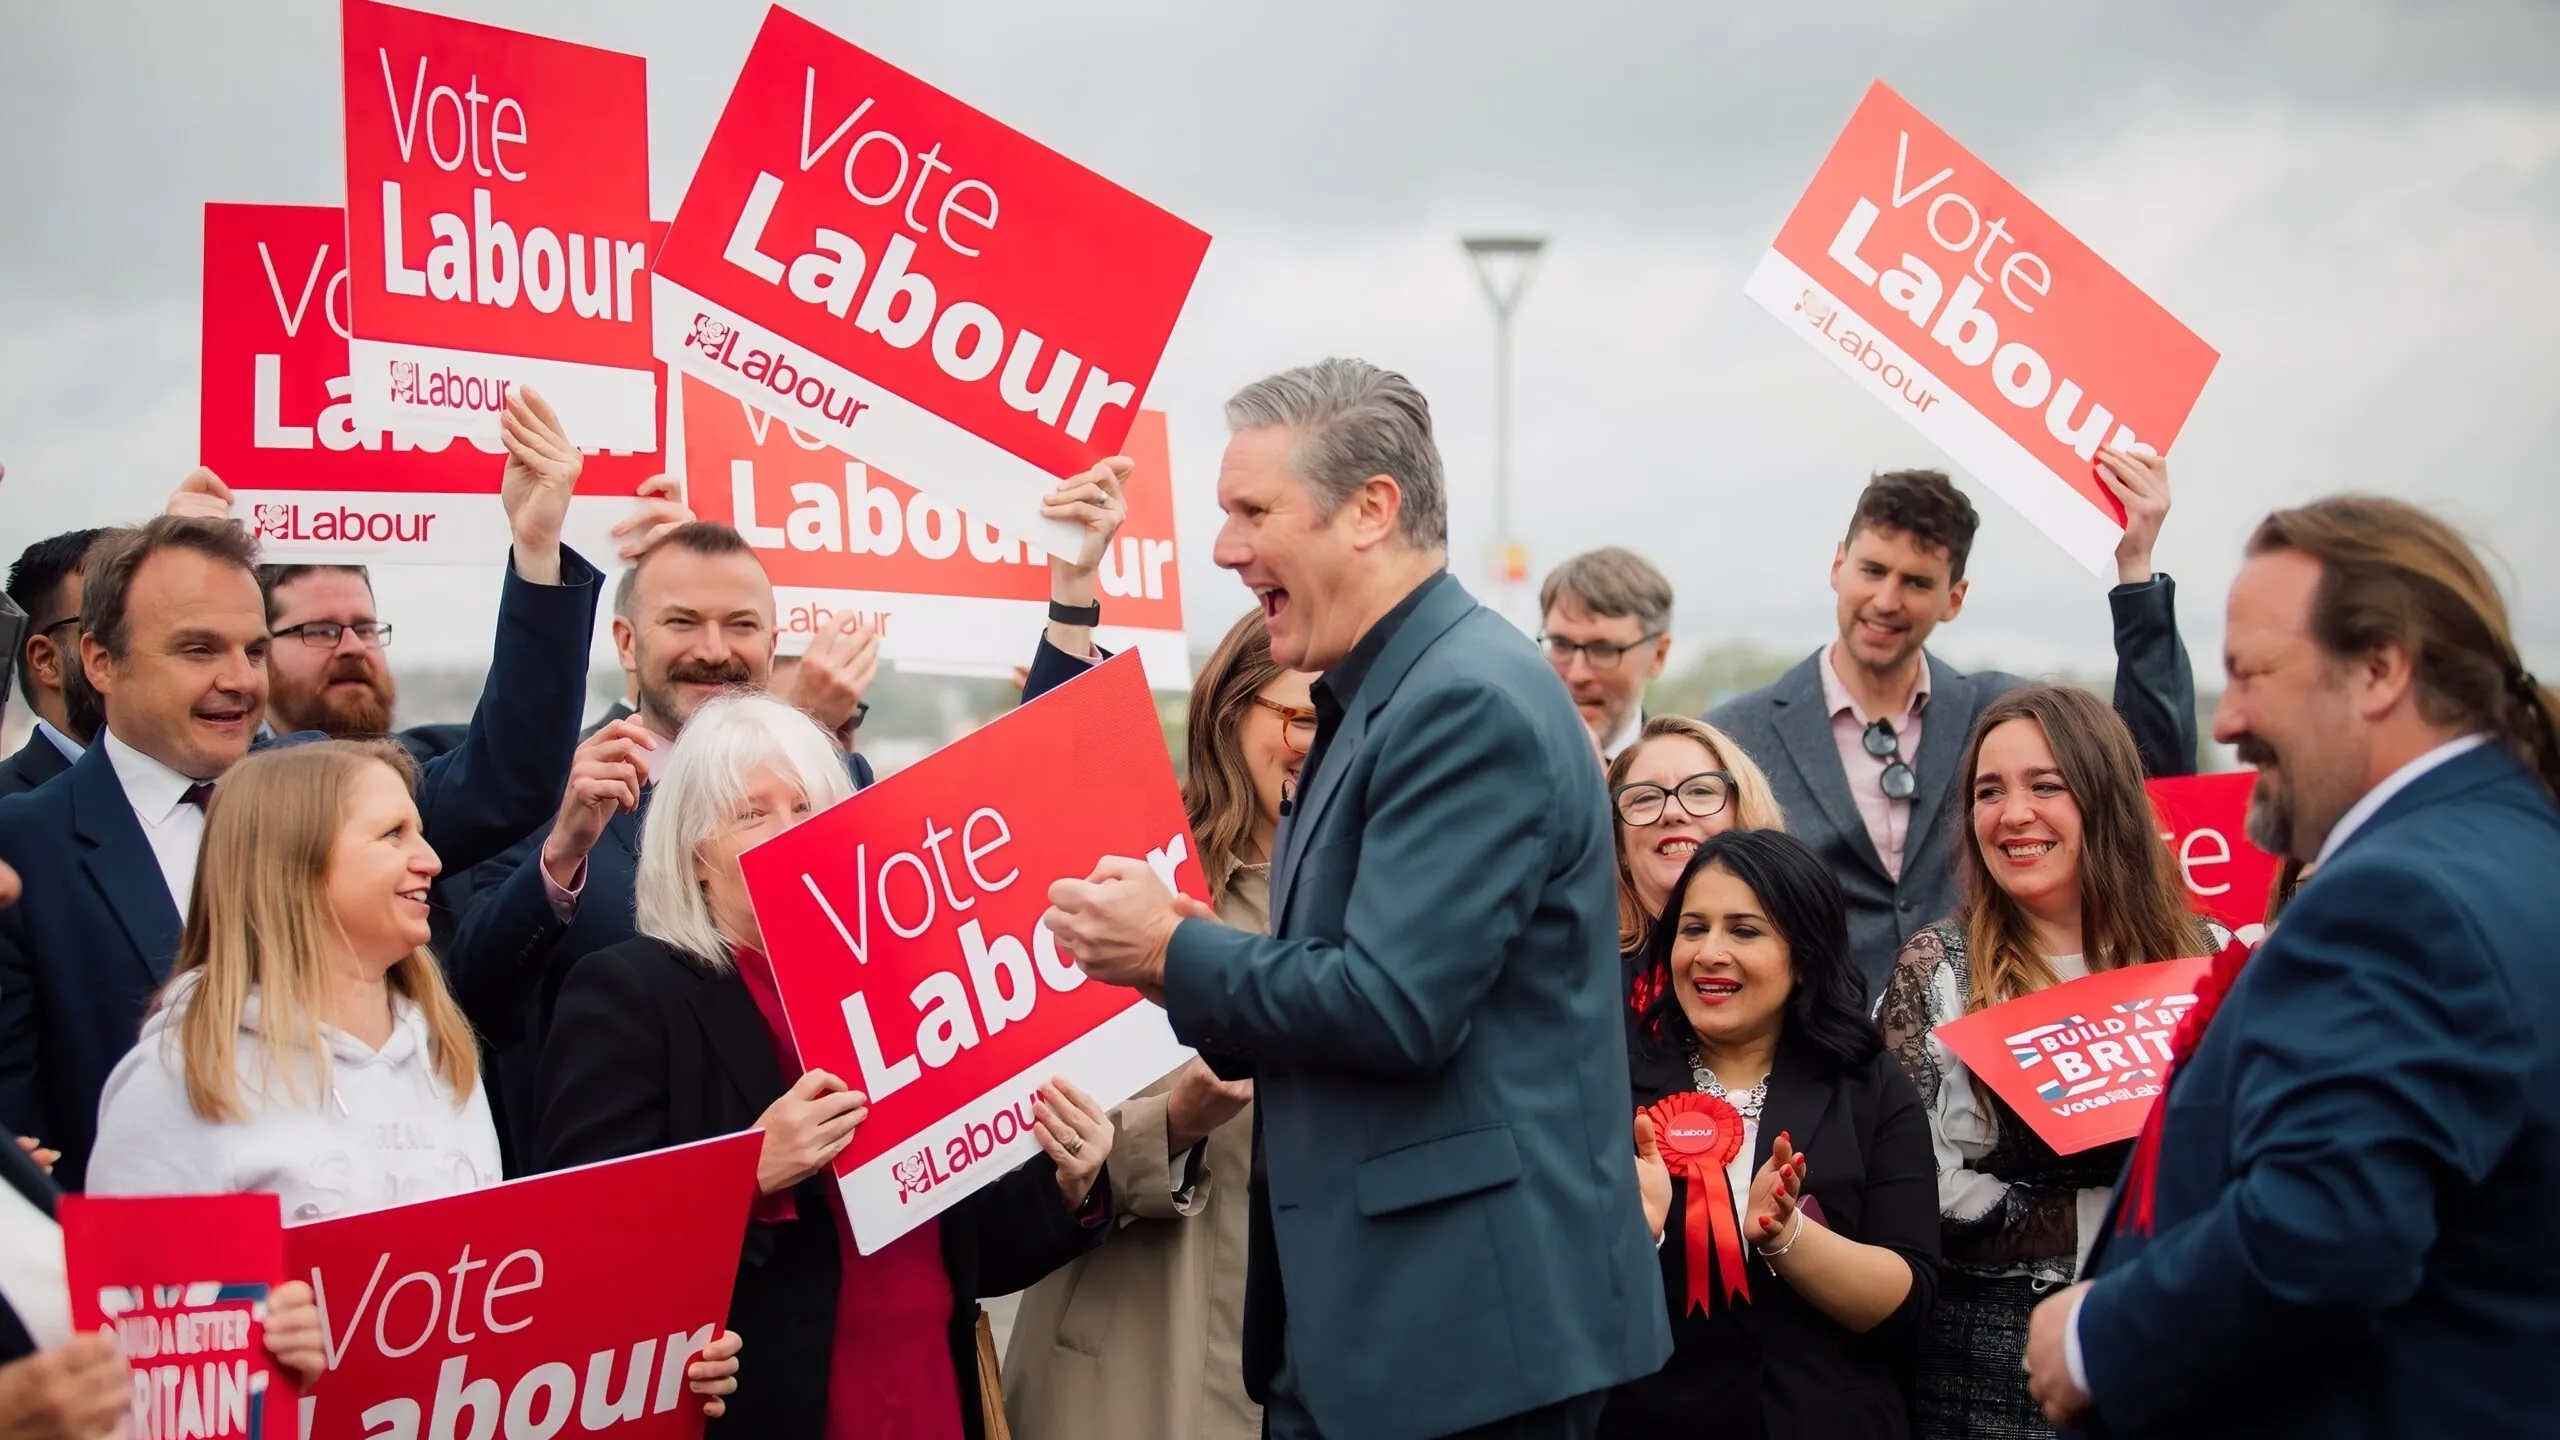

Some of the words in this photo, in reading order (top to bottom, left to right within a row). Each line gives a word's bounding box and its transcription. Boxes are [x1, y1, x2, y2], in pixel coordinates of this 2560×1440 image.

[379, 47, 528, 182] Vote
[800, 66, 999, 257] Vote
[382, 180, 645, 323] Labour
[1892, 131, 2051, 313] Vote
[722, 170, 1135, 444] Labour
[415, 362, 510, 412] Labour
[720, 330, 869, 428] Labour
[1822, 309, 1940, 413] Labour
[292, 506, 436, 542] Labour
[801, 806, 1020, 965] Vote
[841, 833, 1188, 1104] Labor
[2040, 1018, 2126, 1053] BUILD
[2135, 1013, 2154, 1030] A
[2051, 1030, 2174, 1083] BRIT
[2051, 1095, 2111, 1117] Vote
[2122, 1084, 2163, 1099] Lab
[175, 1309, 250, 1354] BETTER
[311, 1244, 544, 1371] Vote
[134, 1359, 248, 1440] RITAIN
